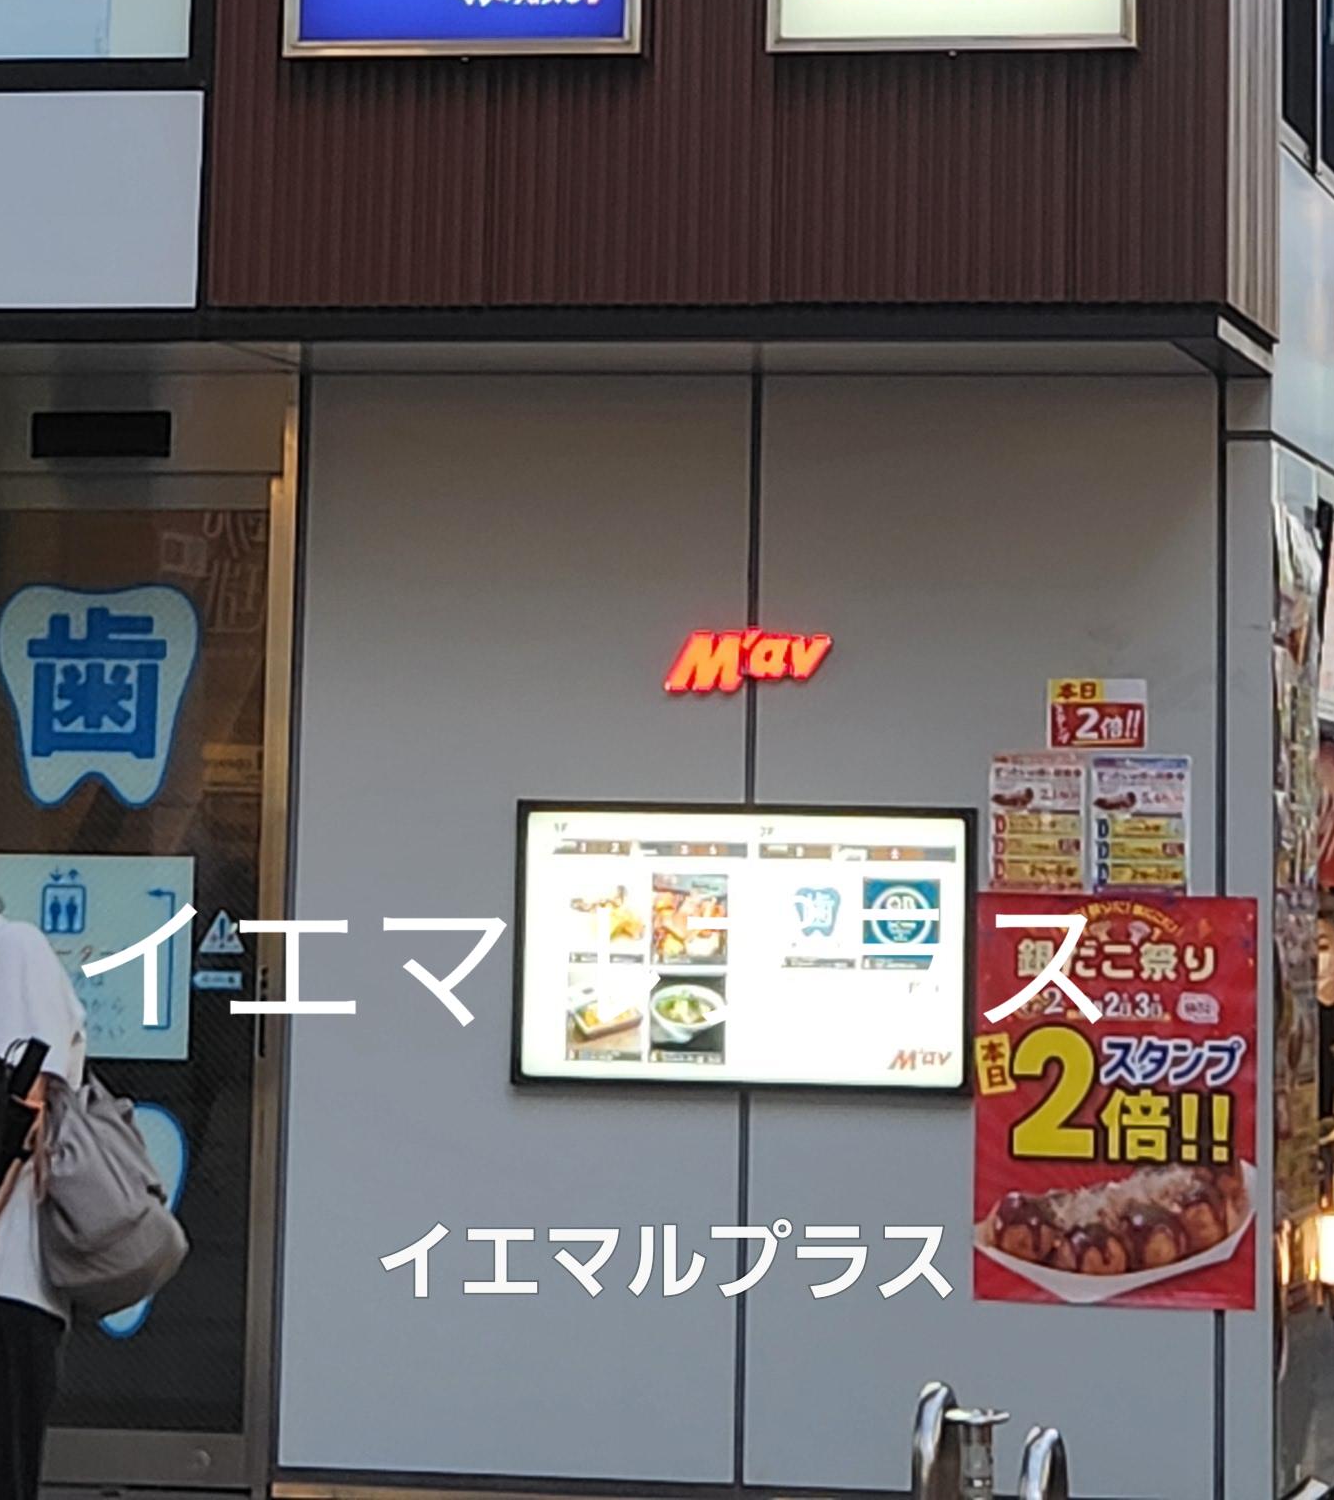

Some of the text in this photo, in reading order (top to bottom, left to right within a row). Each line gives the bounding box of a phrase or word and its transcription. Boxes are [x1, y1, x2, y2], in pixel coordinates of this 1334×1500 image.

[26, 606, 167, 760] 歯
[1058, 681, 1098, 701] 本日
[979, 1039, 1009, 1089] 本日
[1100, 1035, 1247, 1087] スタンプ
